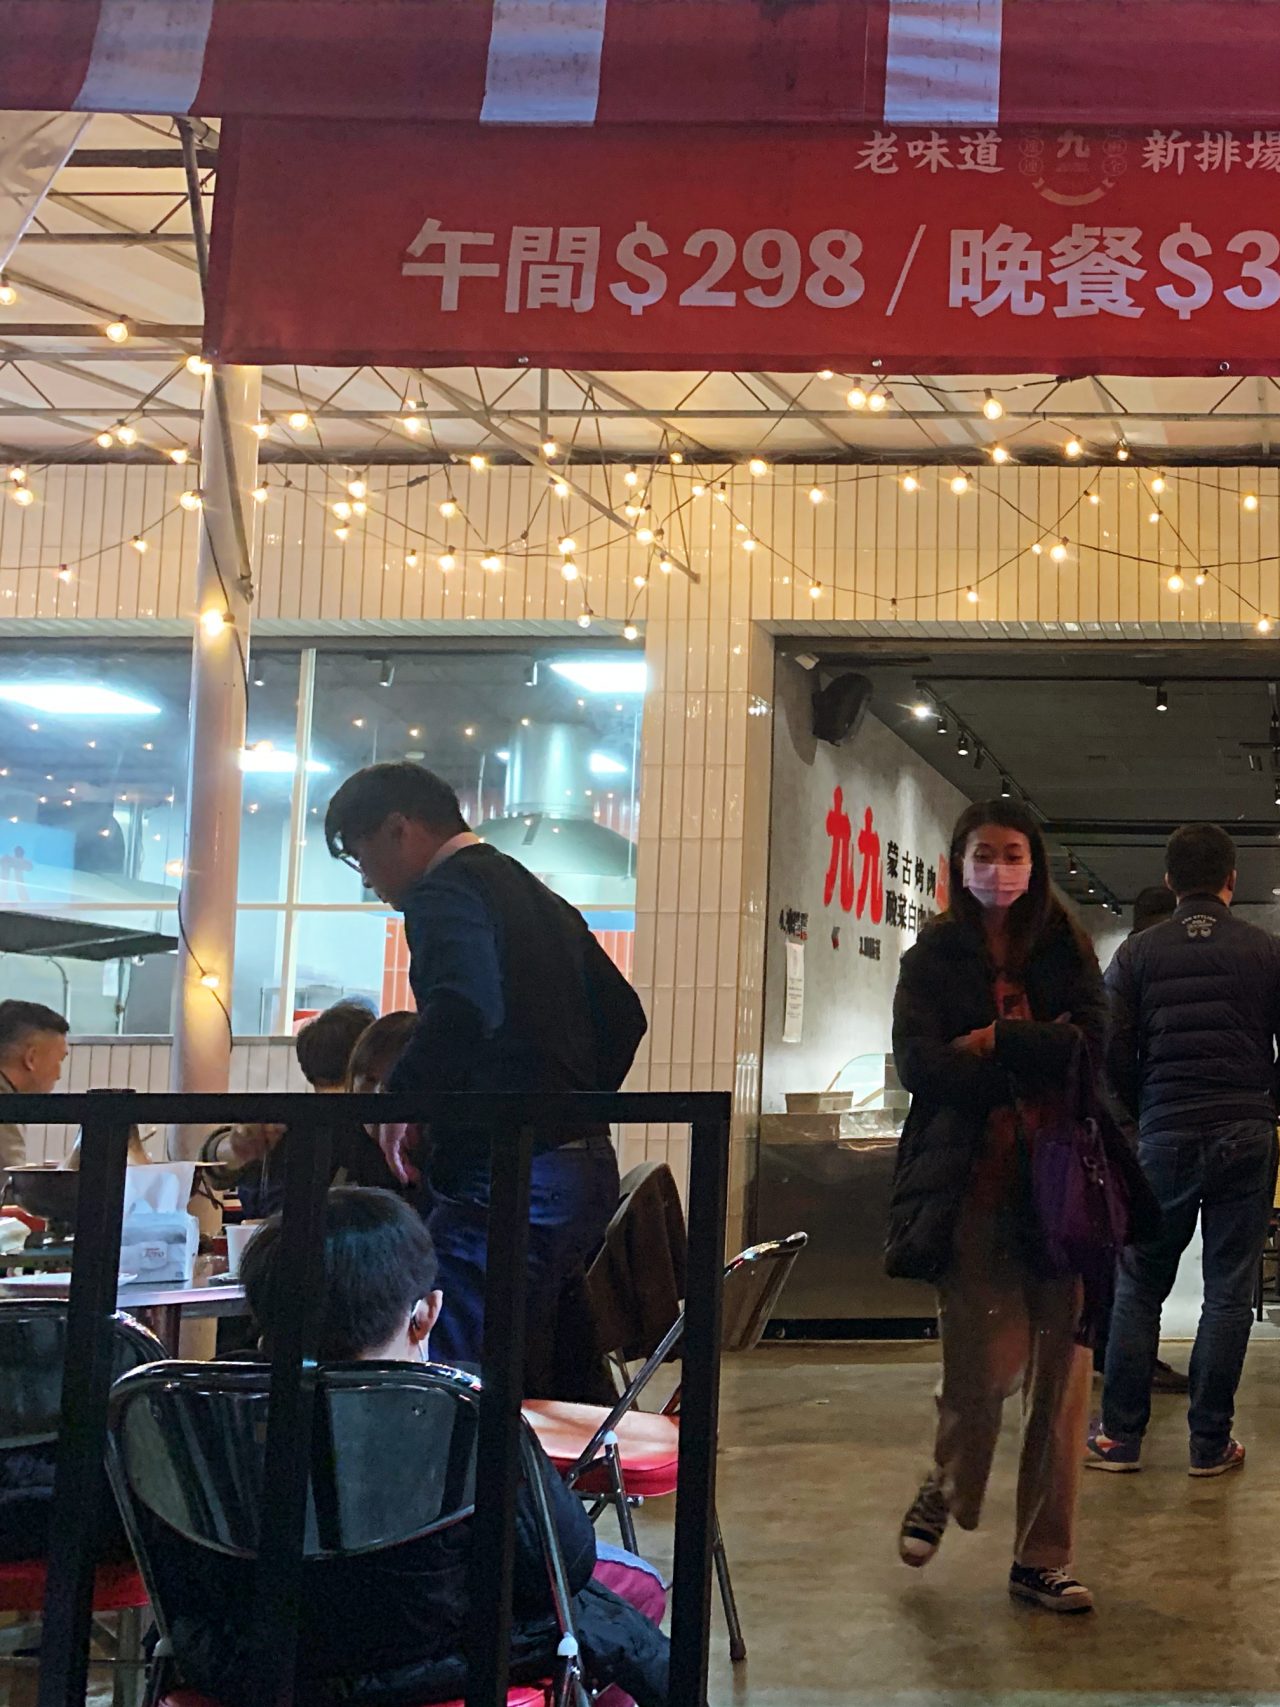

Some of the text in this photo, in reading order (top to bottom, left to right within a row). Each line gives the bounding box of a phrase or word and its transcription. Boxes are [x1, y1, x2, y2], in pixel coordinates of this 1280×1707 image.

[854, 129, 1004, 175] 老味道
[401, 217, 865, 316] 午間$298
[886, 224, 927, 316] /
[823, 785, 883, 925] 九九
